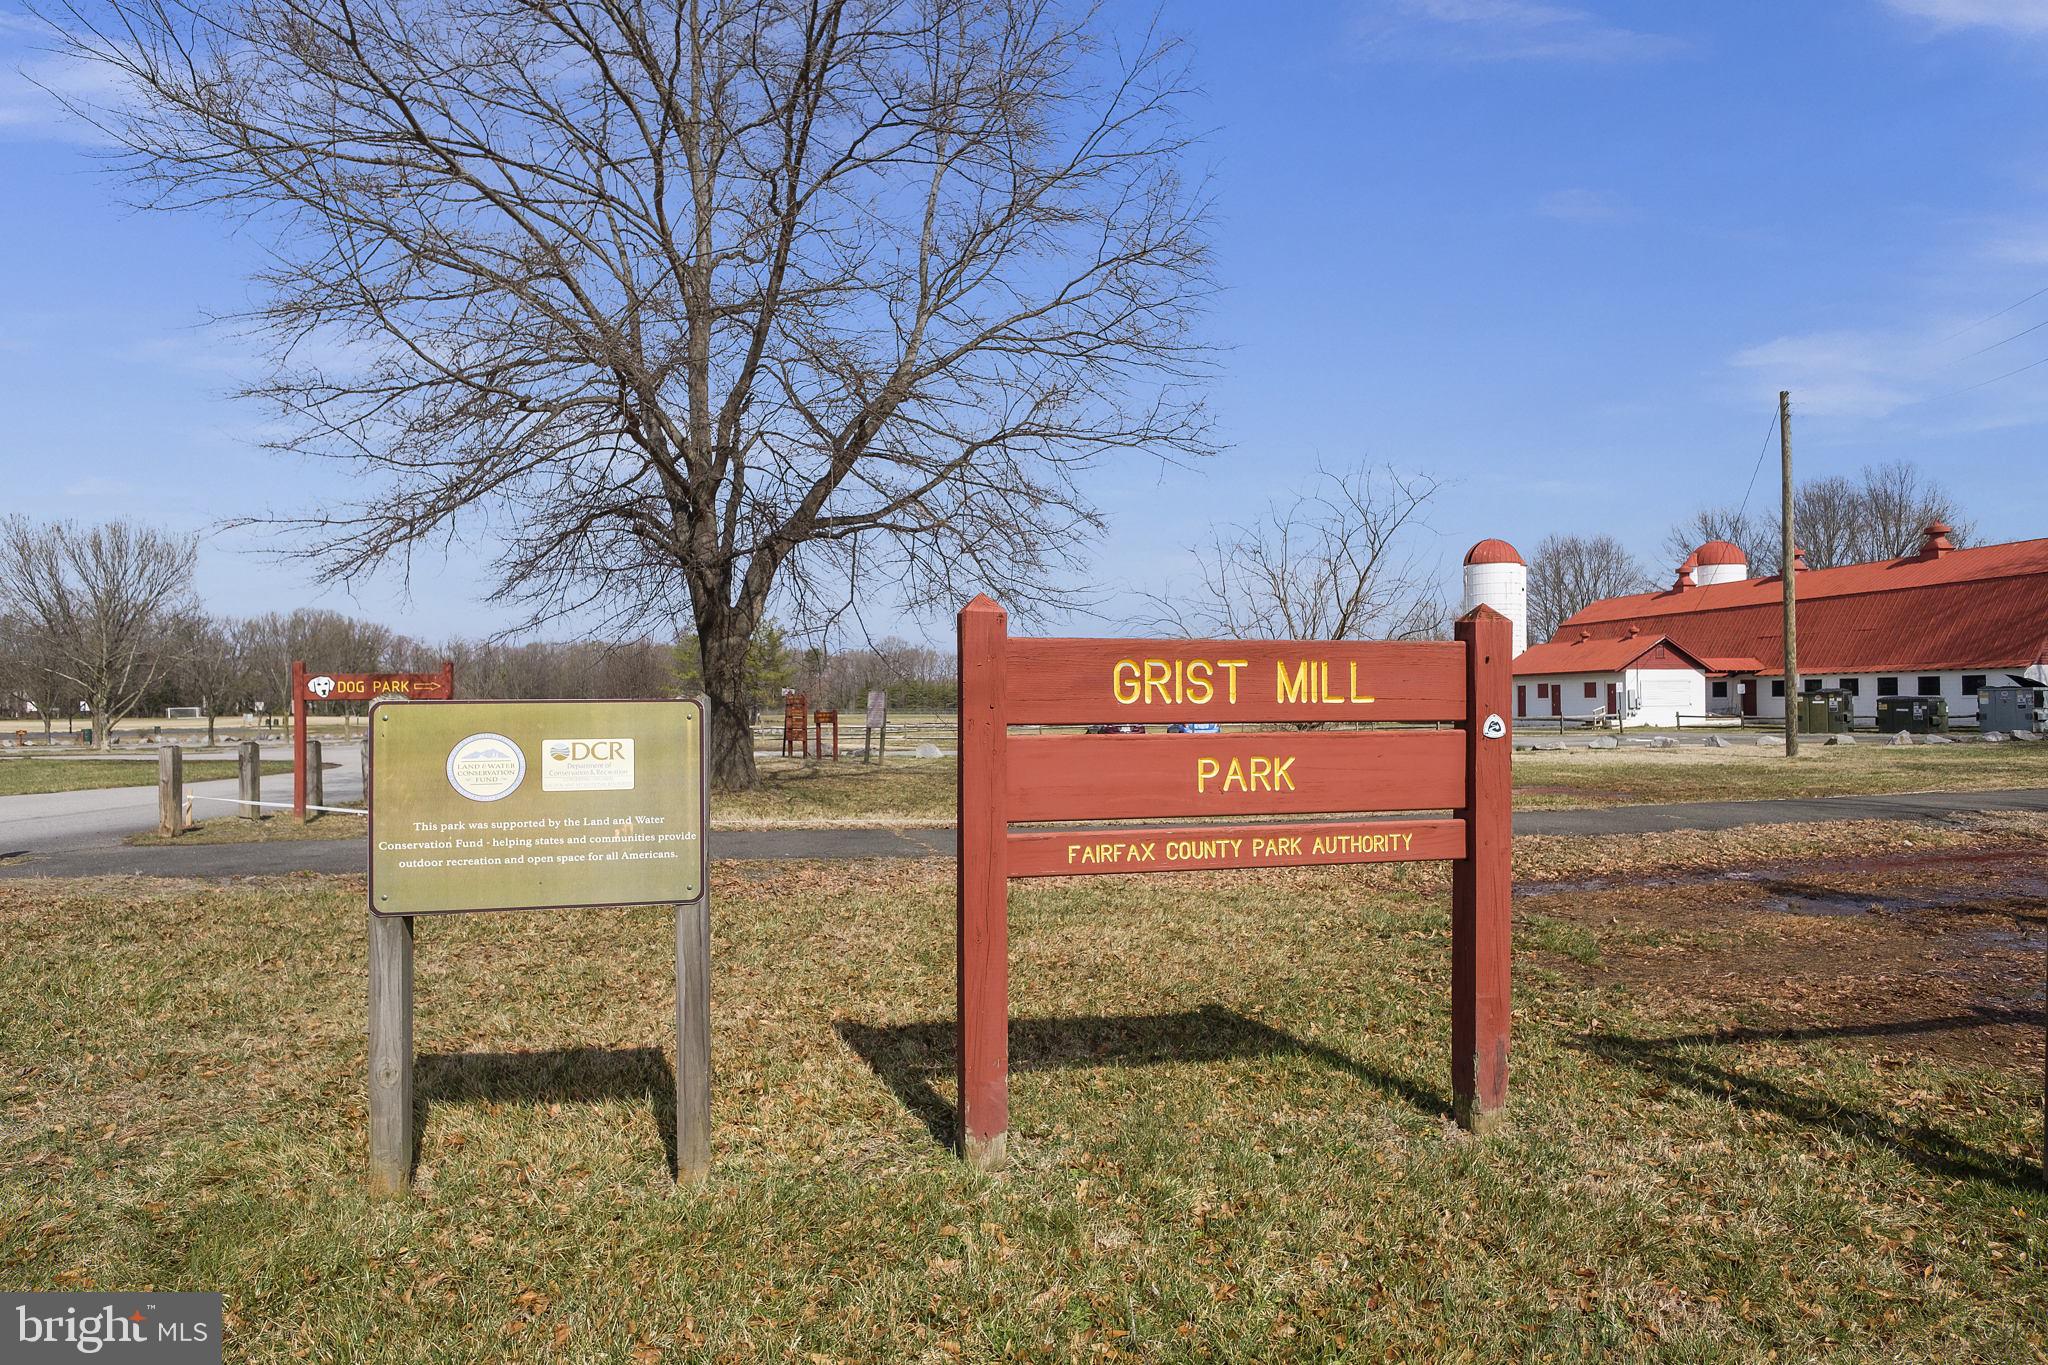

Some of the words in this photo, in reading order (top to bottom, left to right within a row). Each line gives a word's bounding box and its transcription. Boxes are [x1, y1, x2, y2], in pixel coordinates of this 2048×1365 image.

[337, 681, 365, 693] DOG
[373, 680, 409, 693] PARK
[1112, 658, 1249, 706] GRIST
[1276, 659, 1375, 706] MILL
[571, 741, 625, 760] DCR
[1197, 756, 1296, 794] PARK
[413, 822, 438, 831] This
[440, 821, 466, 832] park
[491, 818, 545, 831] supported
[548, 819, 561, 829] by
[564, 818, 580, 827] the
[583, 817, 610, 826] Land
[613, 816, 633, 825] and
[635, 816, 665, 824] Water
[378, 840, 452, 851] Conservation
[455, 839, 483, 848] Fund
[492, 837, 532, 848] helping
[534, 836, 564, 845] states
[567, 835, 587, 844] and
[589, 833, 656, 844] communities
[658, 831, 697, 843] provide
[1067, 841, 1156, 865] FAIRFAX
[1165, 837, 1243, 861] COUNTY
[1252, 836, 1303, 857] PARK
[1312, 832, 1414, 856] AUTHORITY
[398, 858, 443, 868] outdoor
[446, 856, 502, 867] recreation
[504, 855, 524, 864] and
[527, 855, 554, 866] open
[556, 854, 585, 864] space
[588, 851, 604, 861] for
[606, 851, 619, 860] all
[621, 850, 678, 860] Americans.
